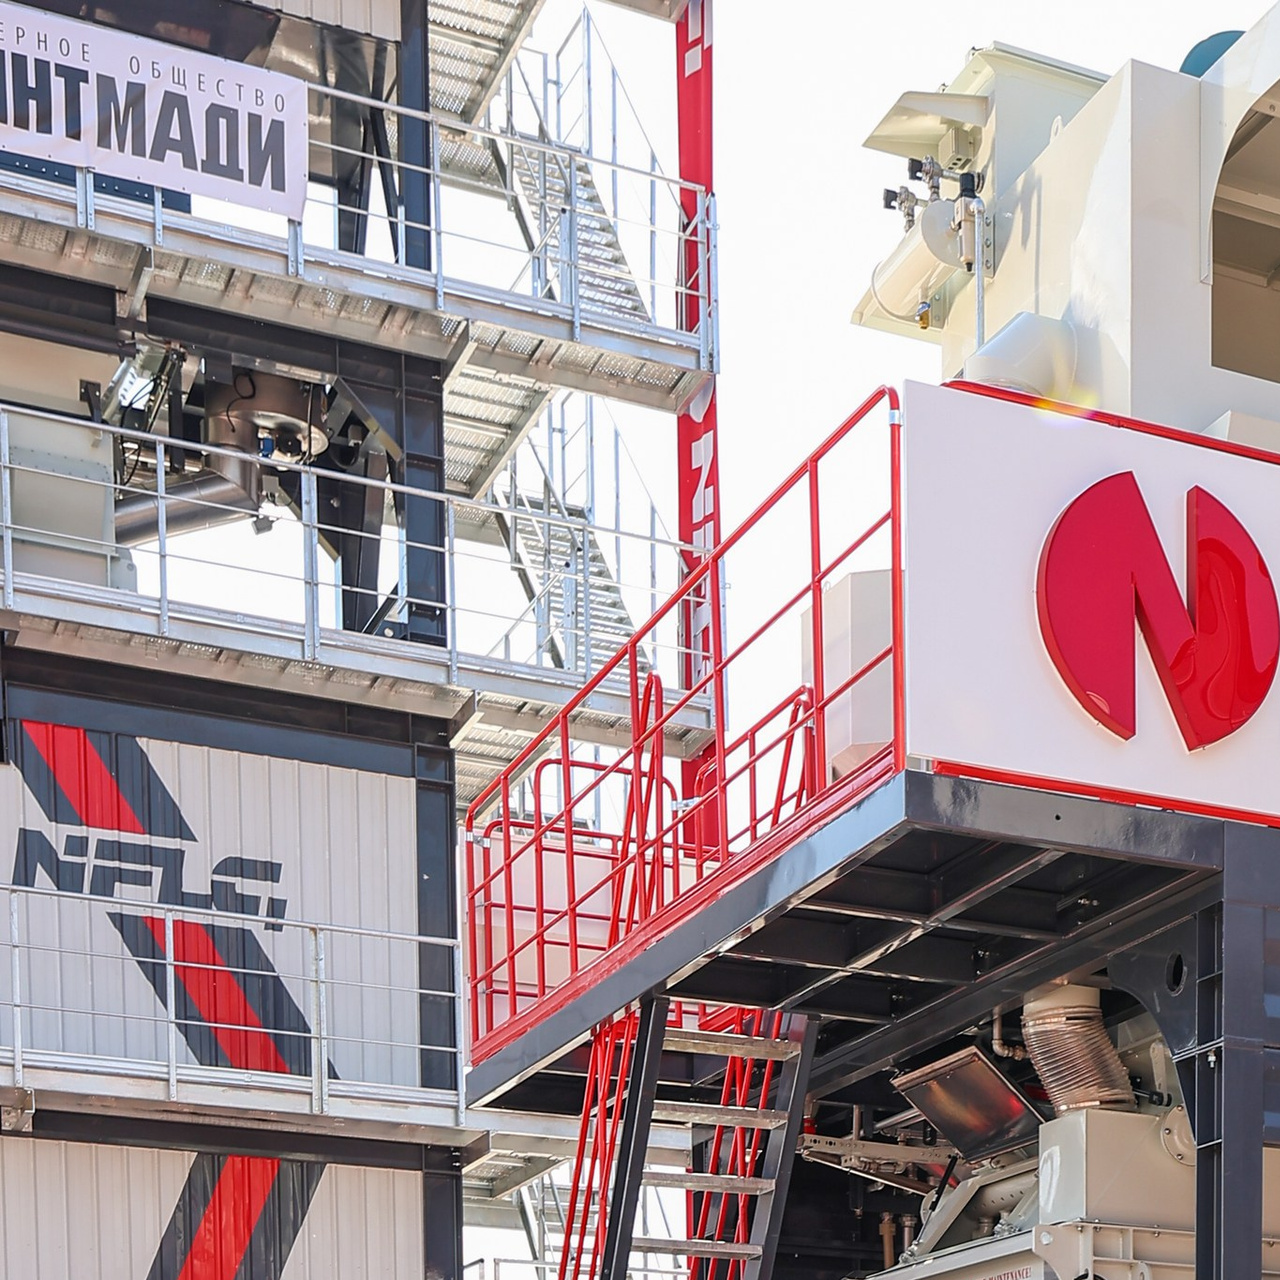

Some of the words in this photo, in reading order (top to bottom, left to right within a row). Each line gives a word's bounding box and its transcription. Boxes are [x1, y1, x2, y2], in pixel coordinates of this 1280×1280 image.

[0, 49, 287, 193] НТМАДИ
[129, 55, 286, 113] ОБЩЕСТВО
[12, 827, 288, 933] NFLG
